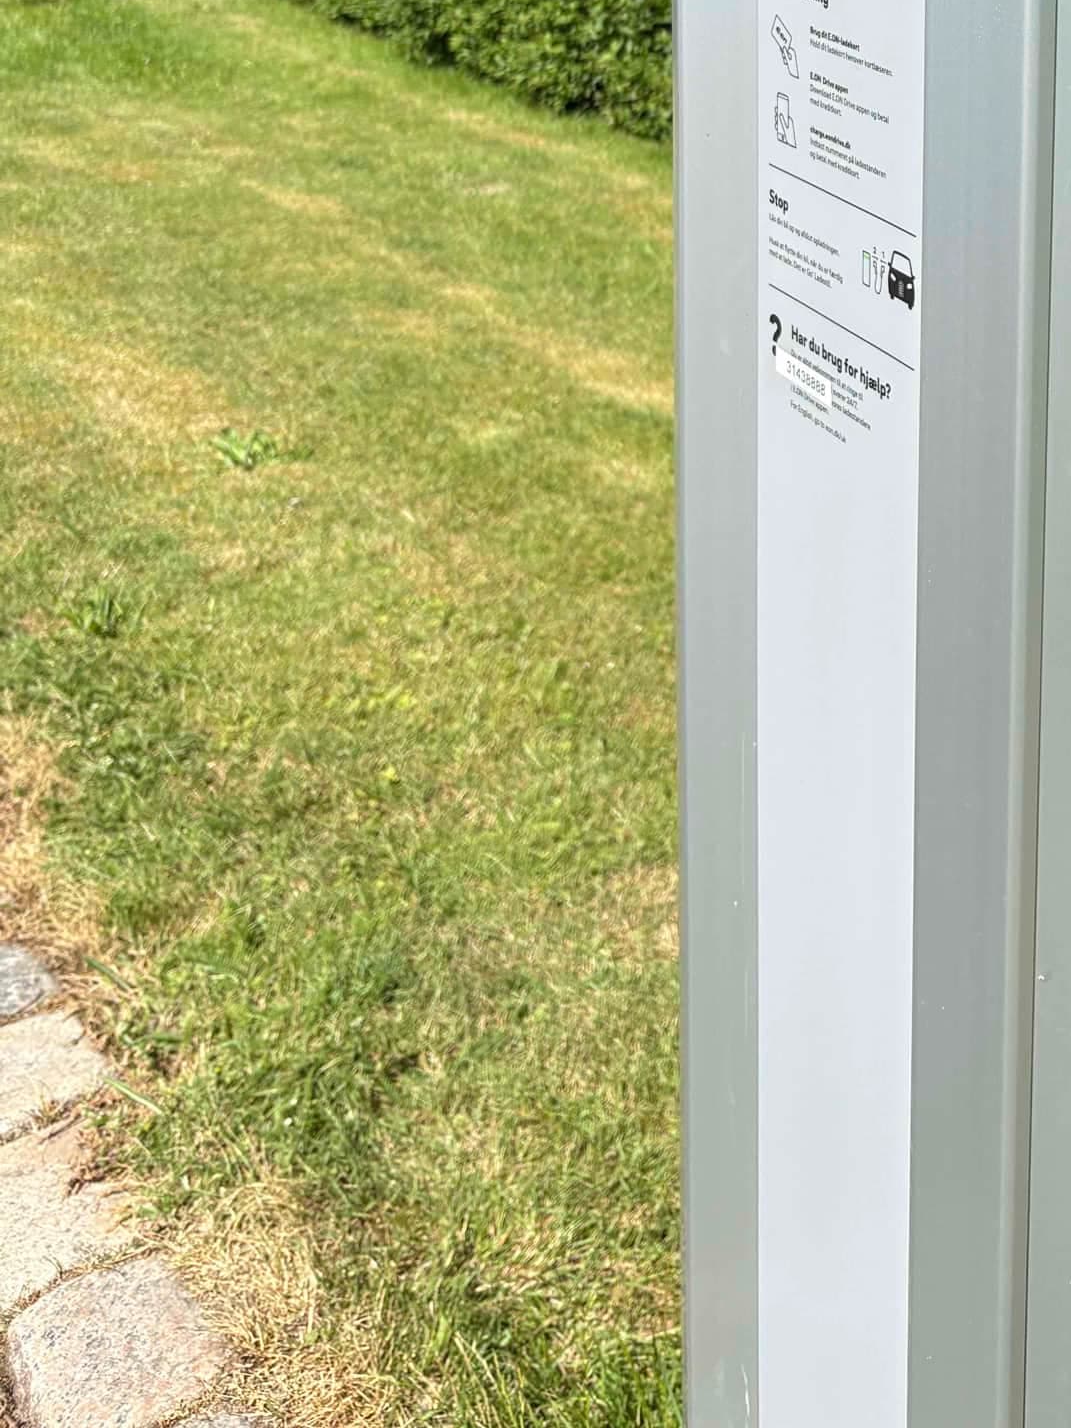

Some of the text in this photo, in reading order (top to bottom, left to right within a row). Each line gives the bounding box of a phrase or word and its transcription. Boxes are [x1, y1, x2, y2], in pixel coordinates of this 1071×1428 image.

[769, 189, 789, 215] Stop
[791, 325, 892, 399] Har du brug for hjælp?
